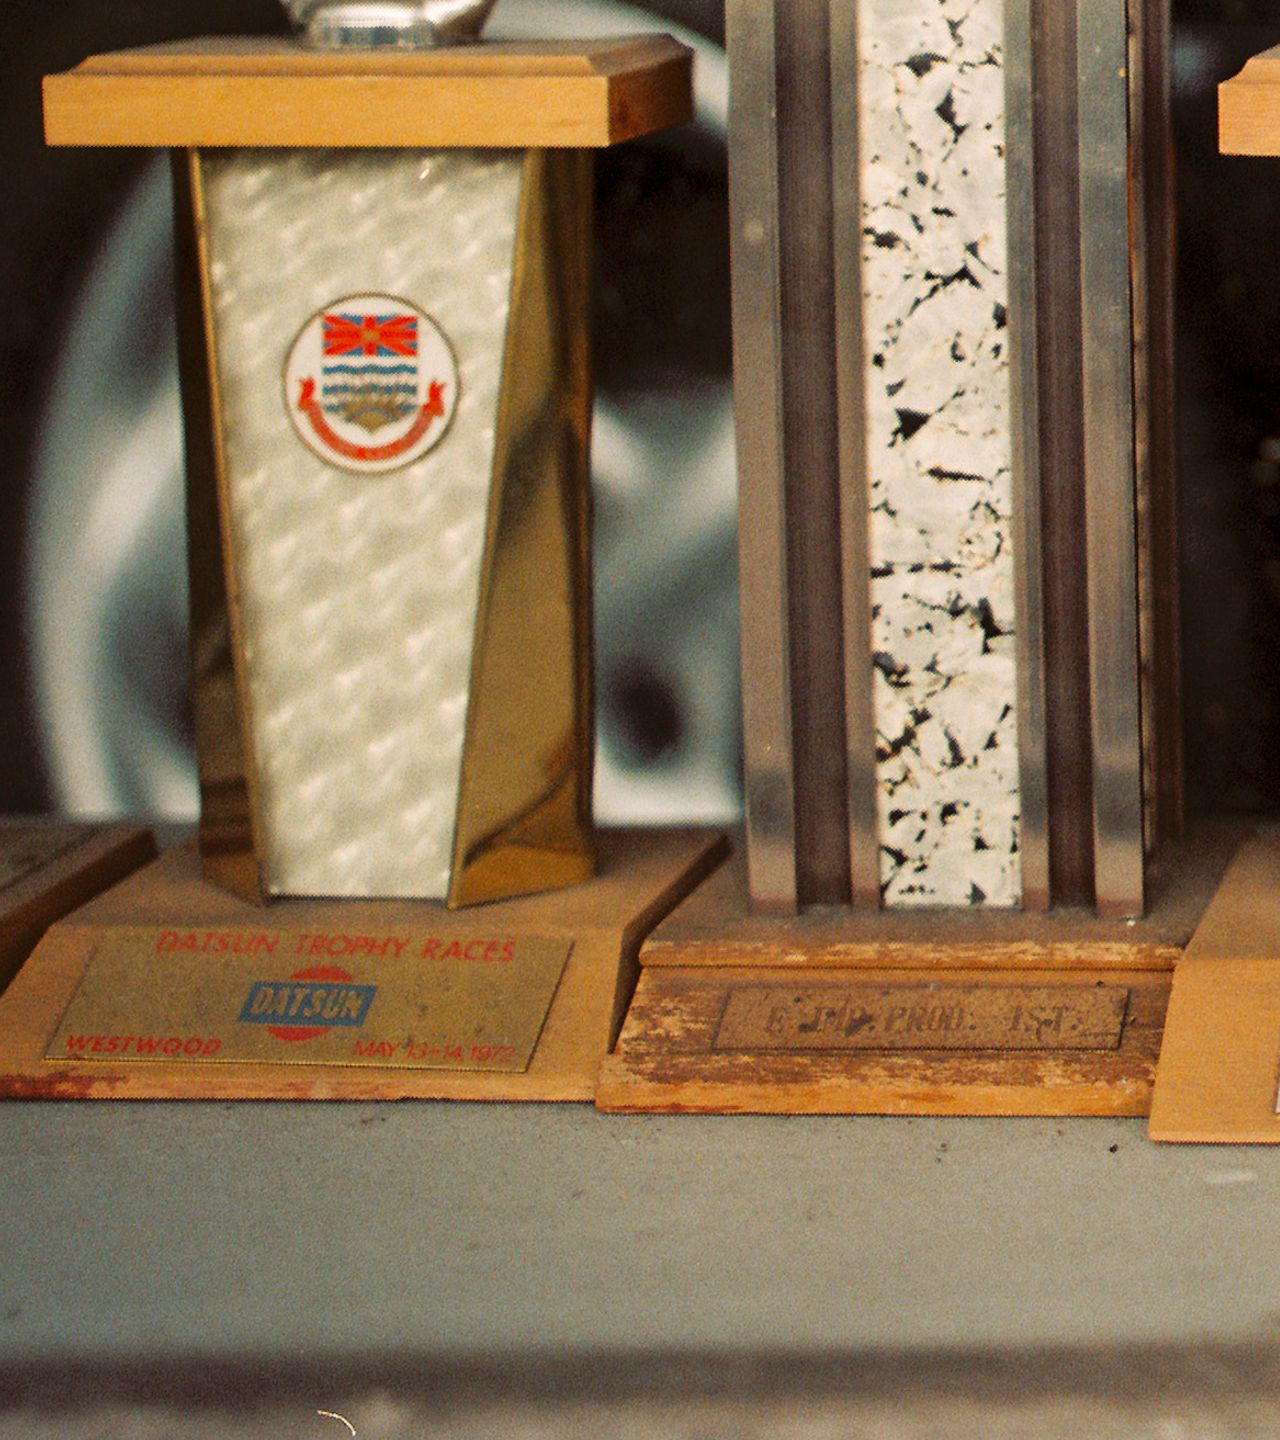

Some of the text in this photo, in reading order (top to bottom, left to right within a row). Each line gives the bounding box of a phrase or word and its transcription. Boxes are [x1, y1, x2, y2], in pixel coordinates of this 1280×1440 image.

[157, 931, 516, 962] DATSUN TROPHY RACES
[250, 987, 365, 1019] DATSUN
[65, 1035, 222, 1056] WESTWOOD
[353, 1040, 400, 1058] MAY
